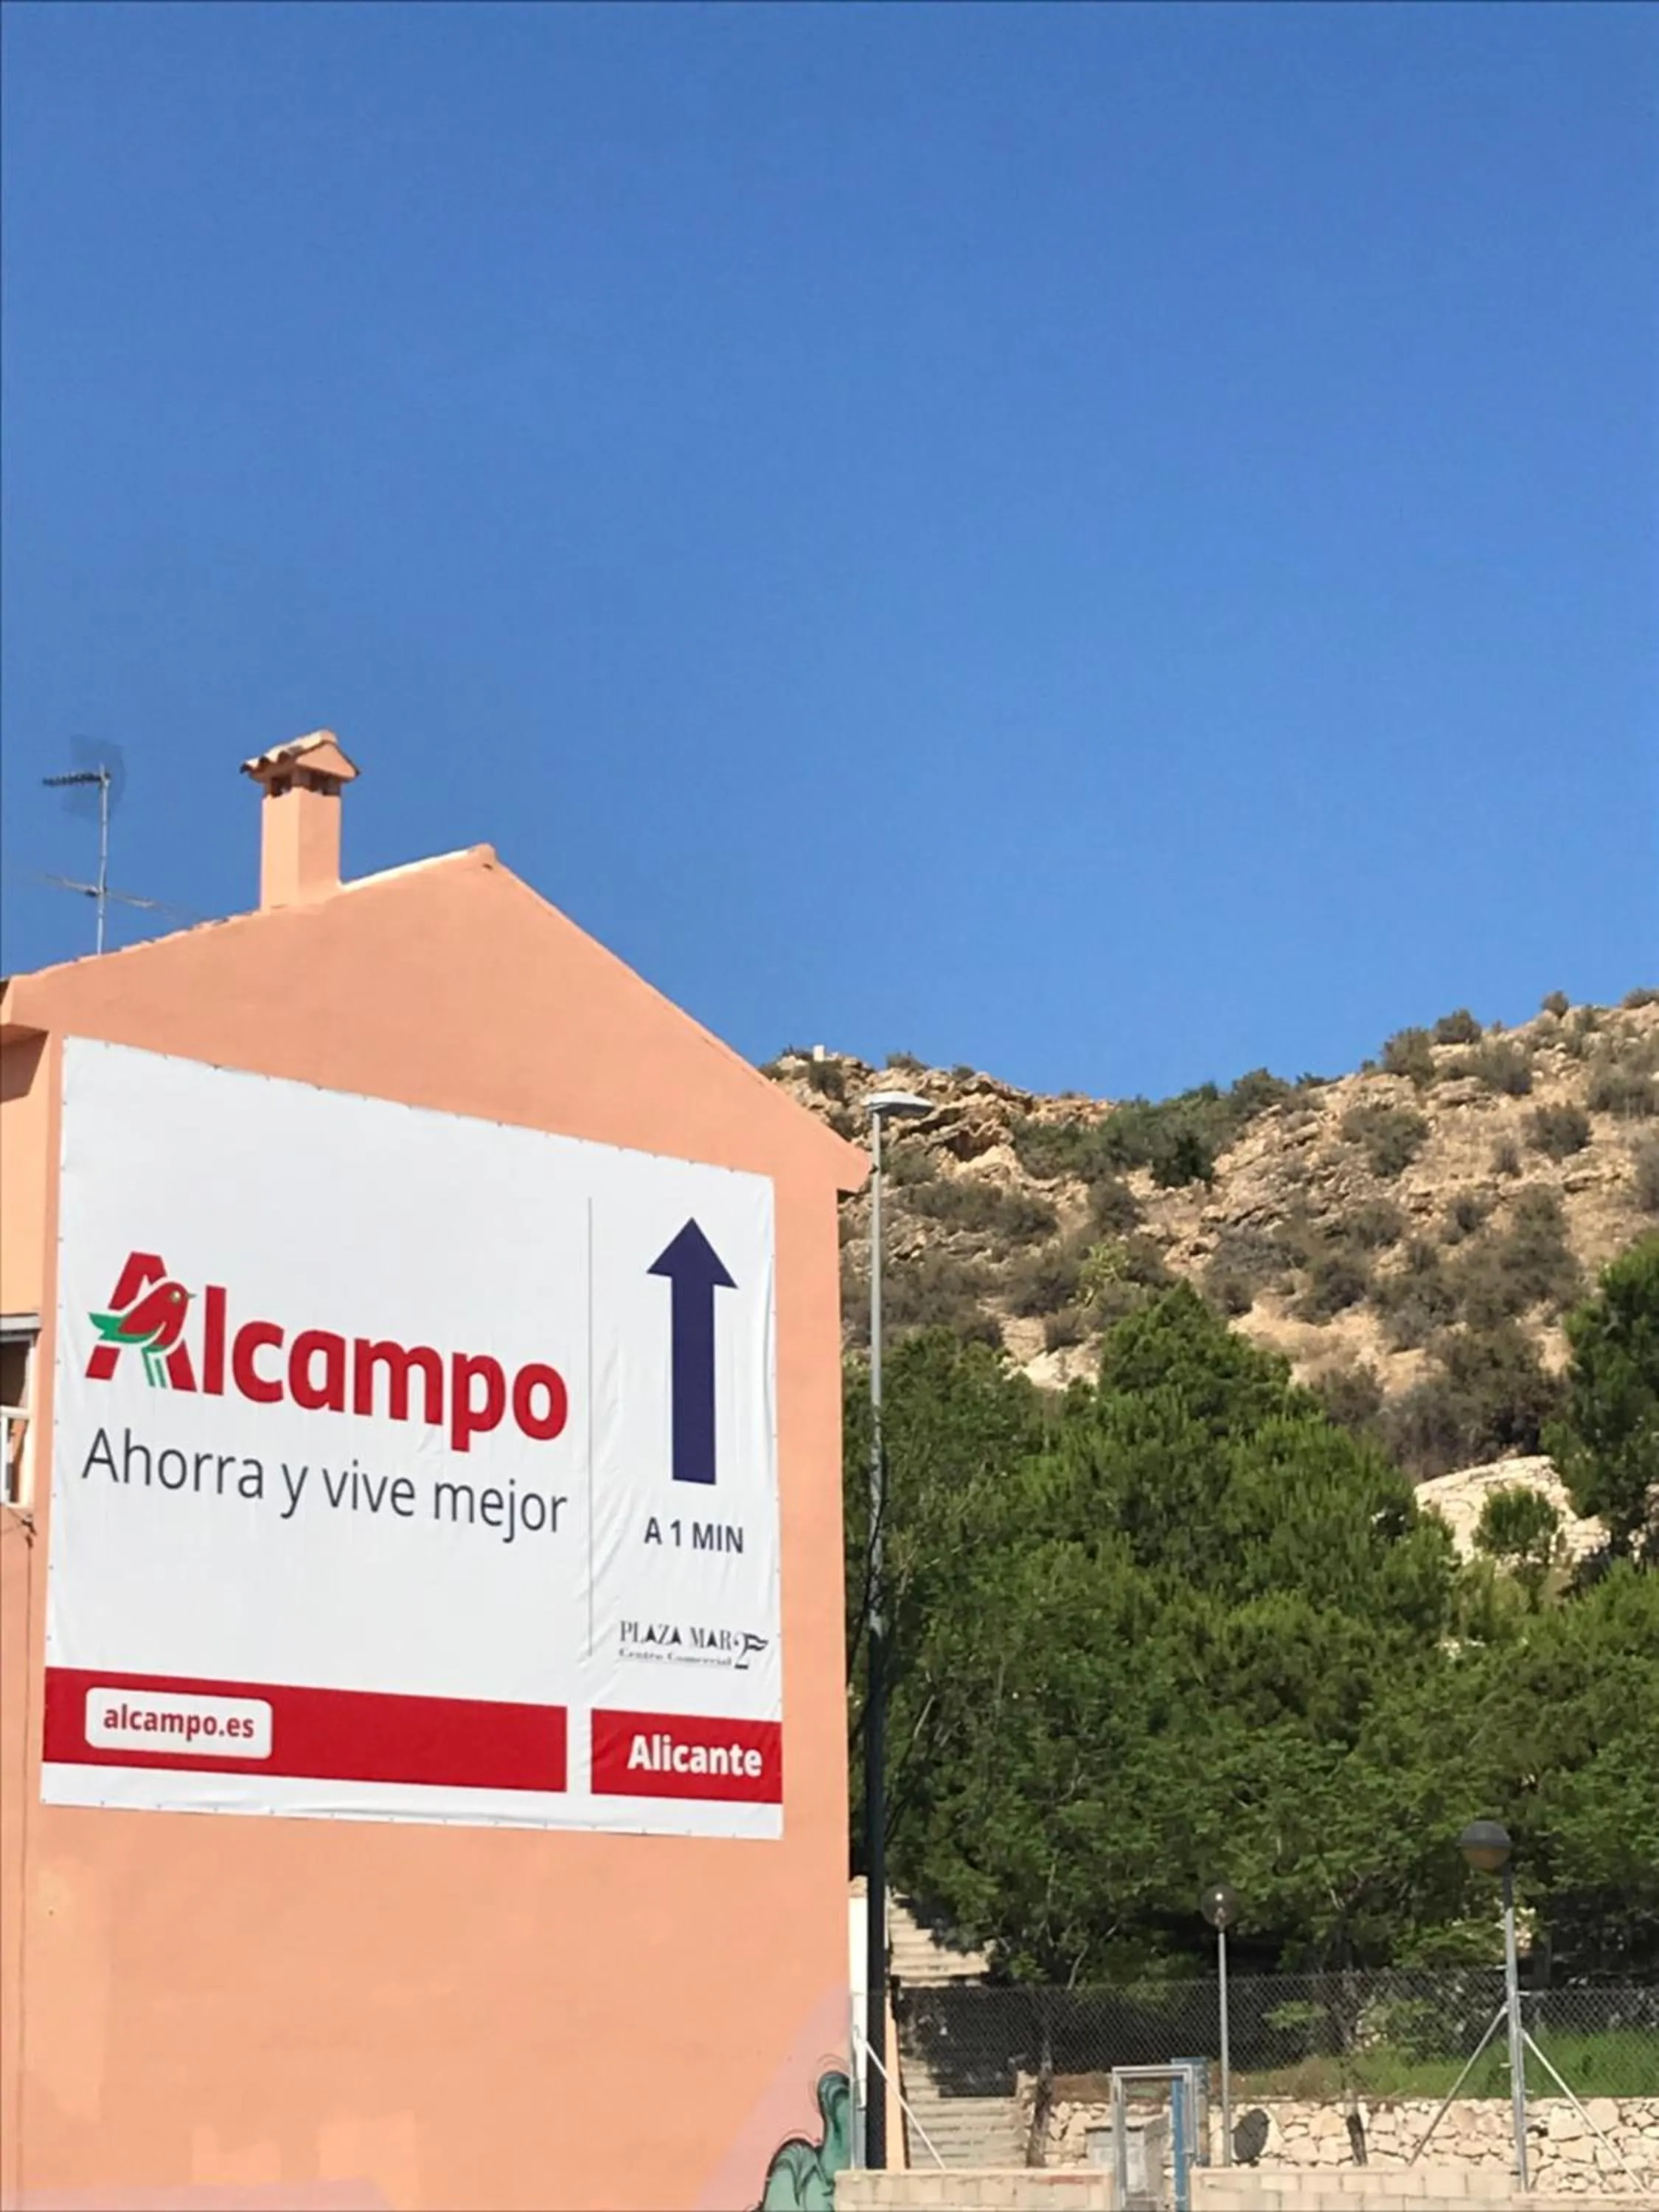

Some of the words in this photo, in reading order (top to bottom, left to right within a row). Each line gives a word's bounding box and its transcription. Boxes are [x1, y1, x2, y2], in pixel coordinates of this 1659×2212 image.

[85, 1251, 568, 1453] Alcampo
[82, 1427, 264, 1498] Ahorra
[280, 1463, 308, 1519] y
[322, 1459, 416, 1516] vive
[434, 1478, 568, 1543] mejor
[644, 1517, 662, 1545] A
[670, 1520, 681, 1546] 1
[692, 1522, 744, 1554] MIN
[620, 1621, 682, 1645] PLAZA
[619, 1649, 664, 1660] Centro
[102, 1703, 255, 1742] alcampo.es
[627, 1734, 762, 1777] Alicante
